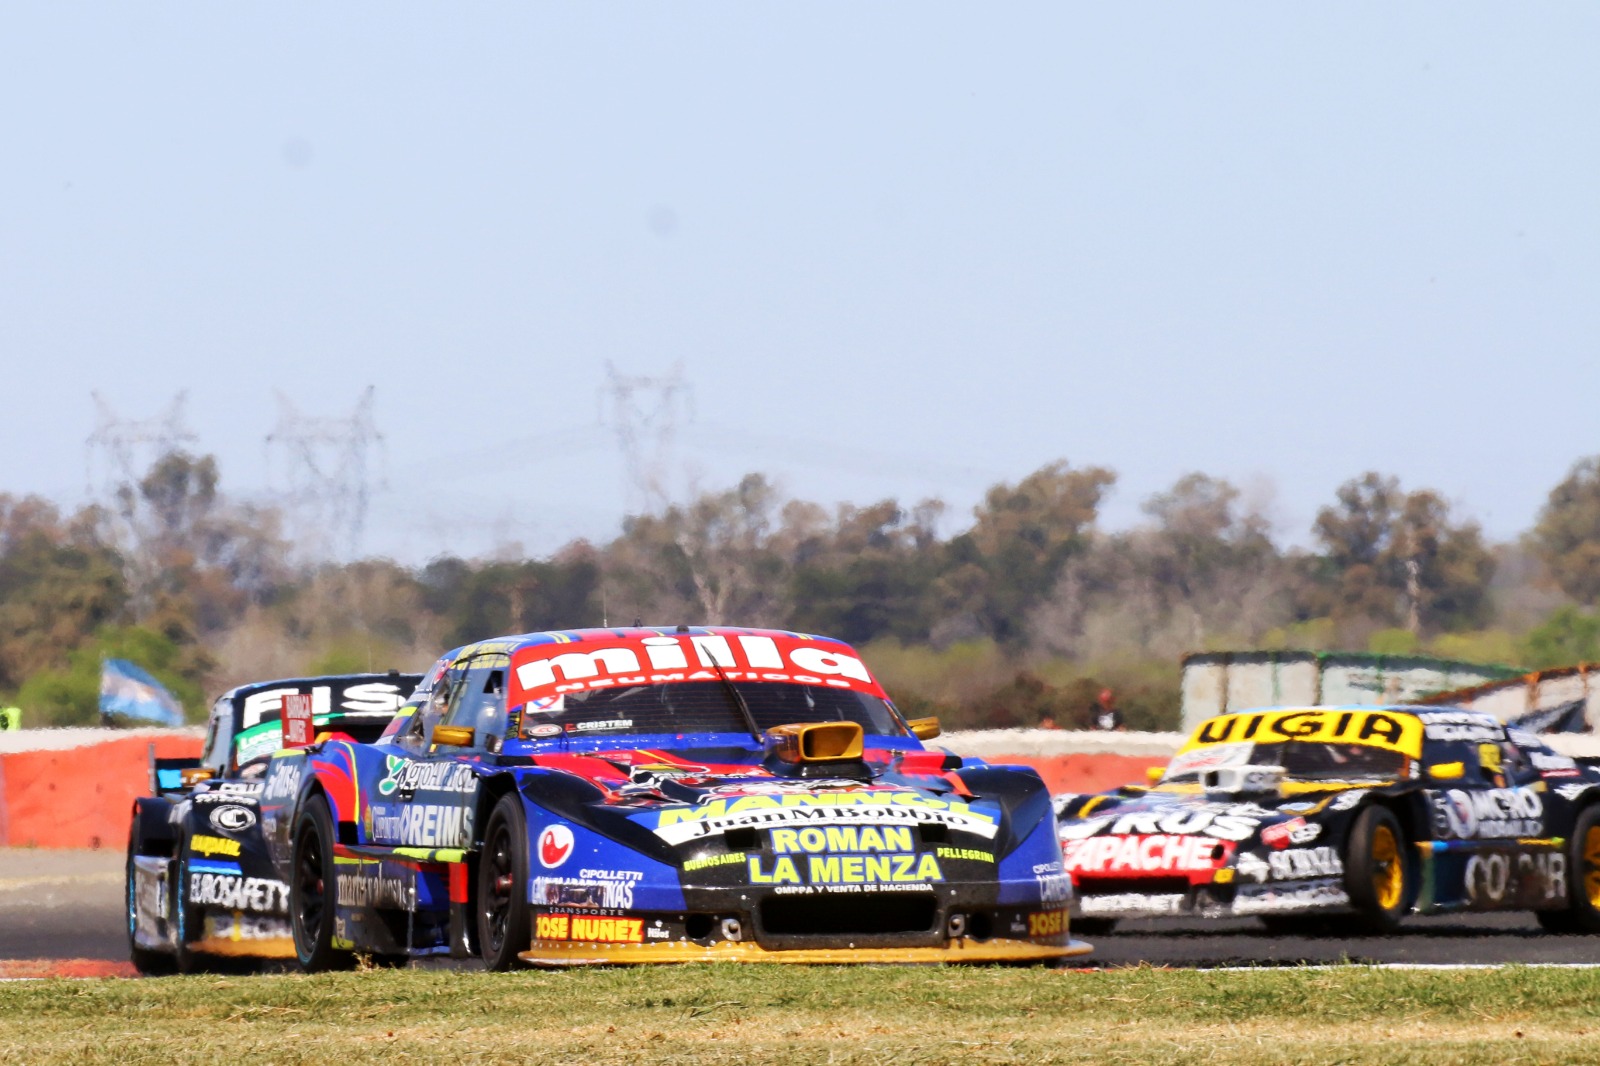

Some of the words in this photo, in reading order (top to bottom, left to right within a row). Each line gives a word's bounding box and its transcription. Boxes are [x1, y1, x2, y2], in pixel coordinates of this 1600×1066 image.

[516, 635, 872, 691] milla
[577, 720, 633, 730] CRISTEM
[408, 805, 473, 848] REIMS
[772, 825, 913, 852] ROMAN
[683, 855, 720, 872] BUENOS
[720, 852, 746, 866] AIRES
[937, 848, 995, 864] PELLEGRINI
[579, 868, 644, 881] CIPOLLETTI
[749, 857, 801, 883] LA
[809, 854, 943, 884] MENZA
[815, 885, 824, 893] Y
[825, 884, 861, 893] VENTA
[863, 884, 878, 892] DE
[880, 883, 934, 892] HACIENDA
[549, 906, 624, 916] TRANSPORTE
[536, 916, 569, 940] JOSE
